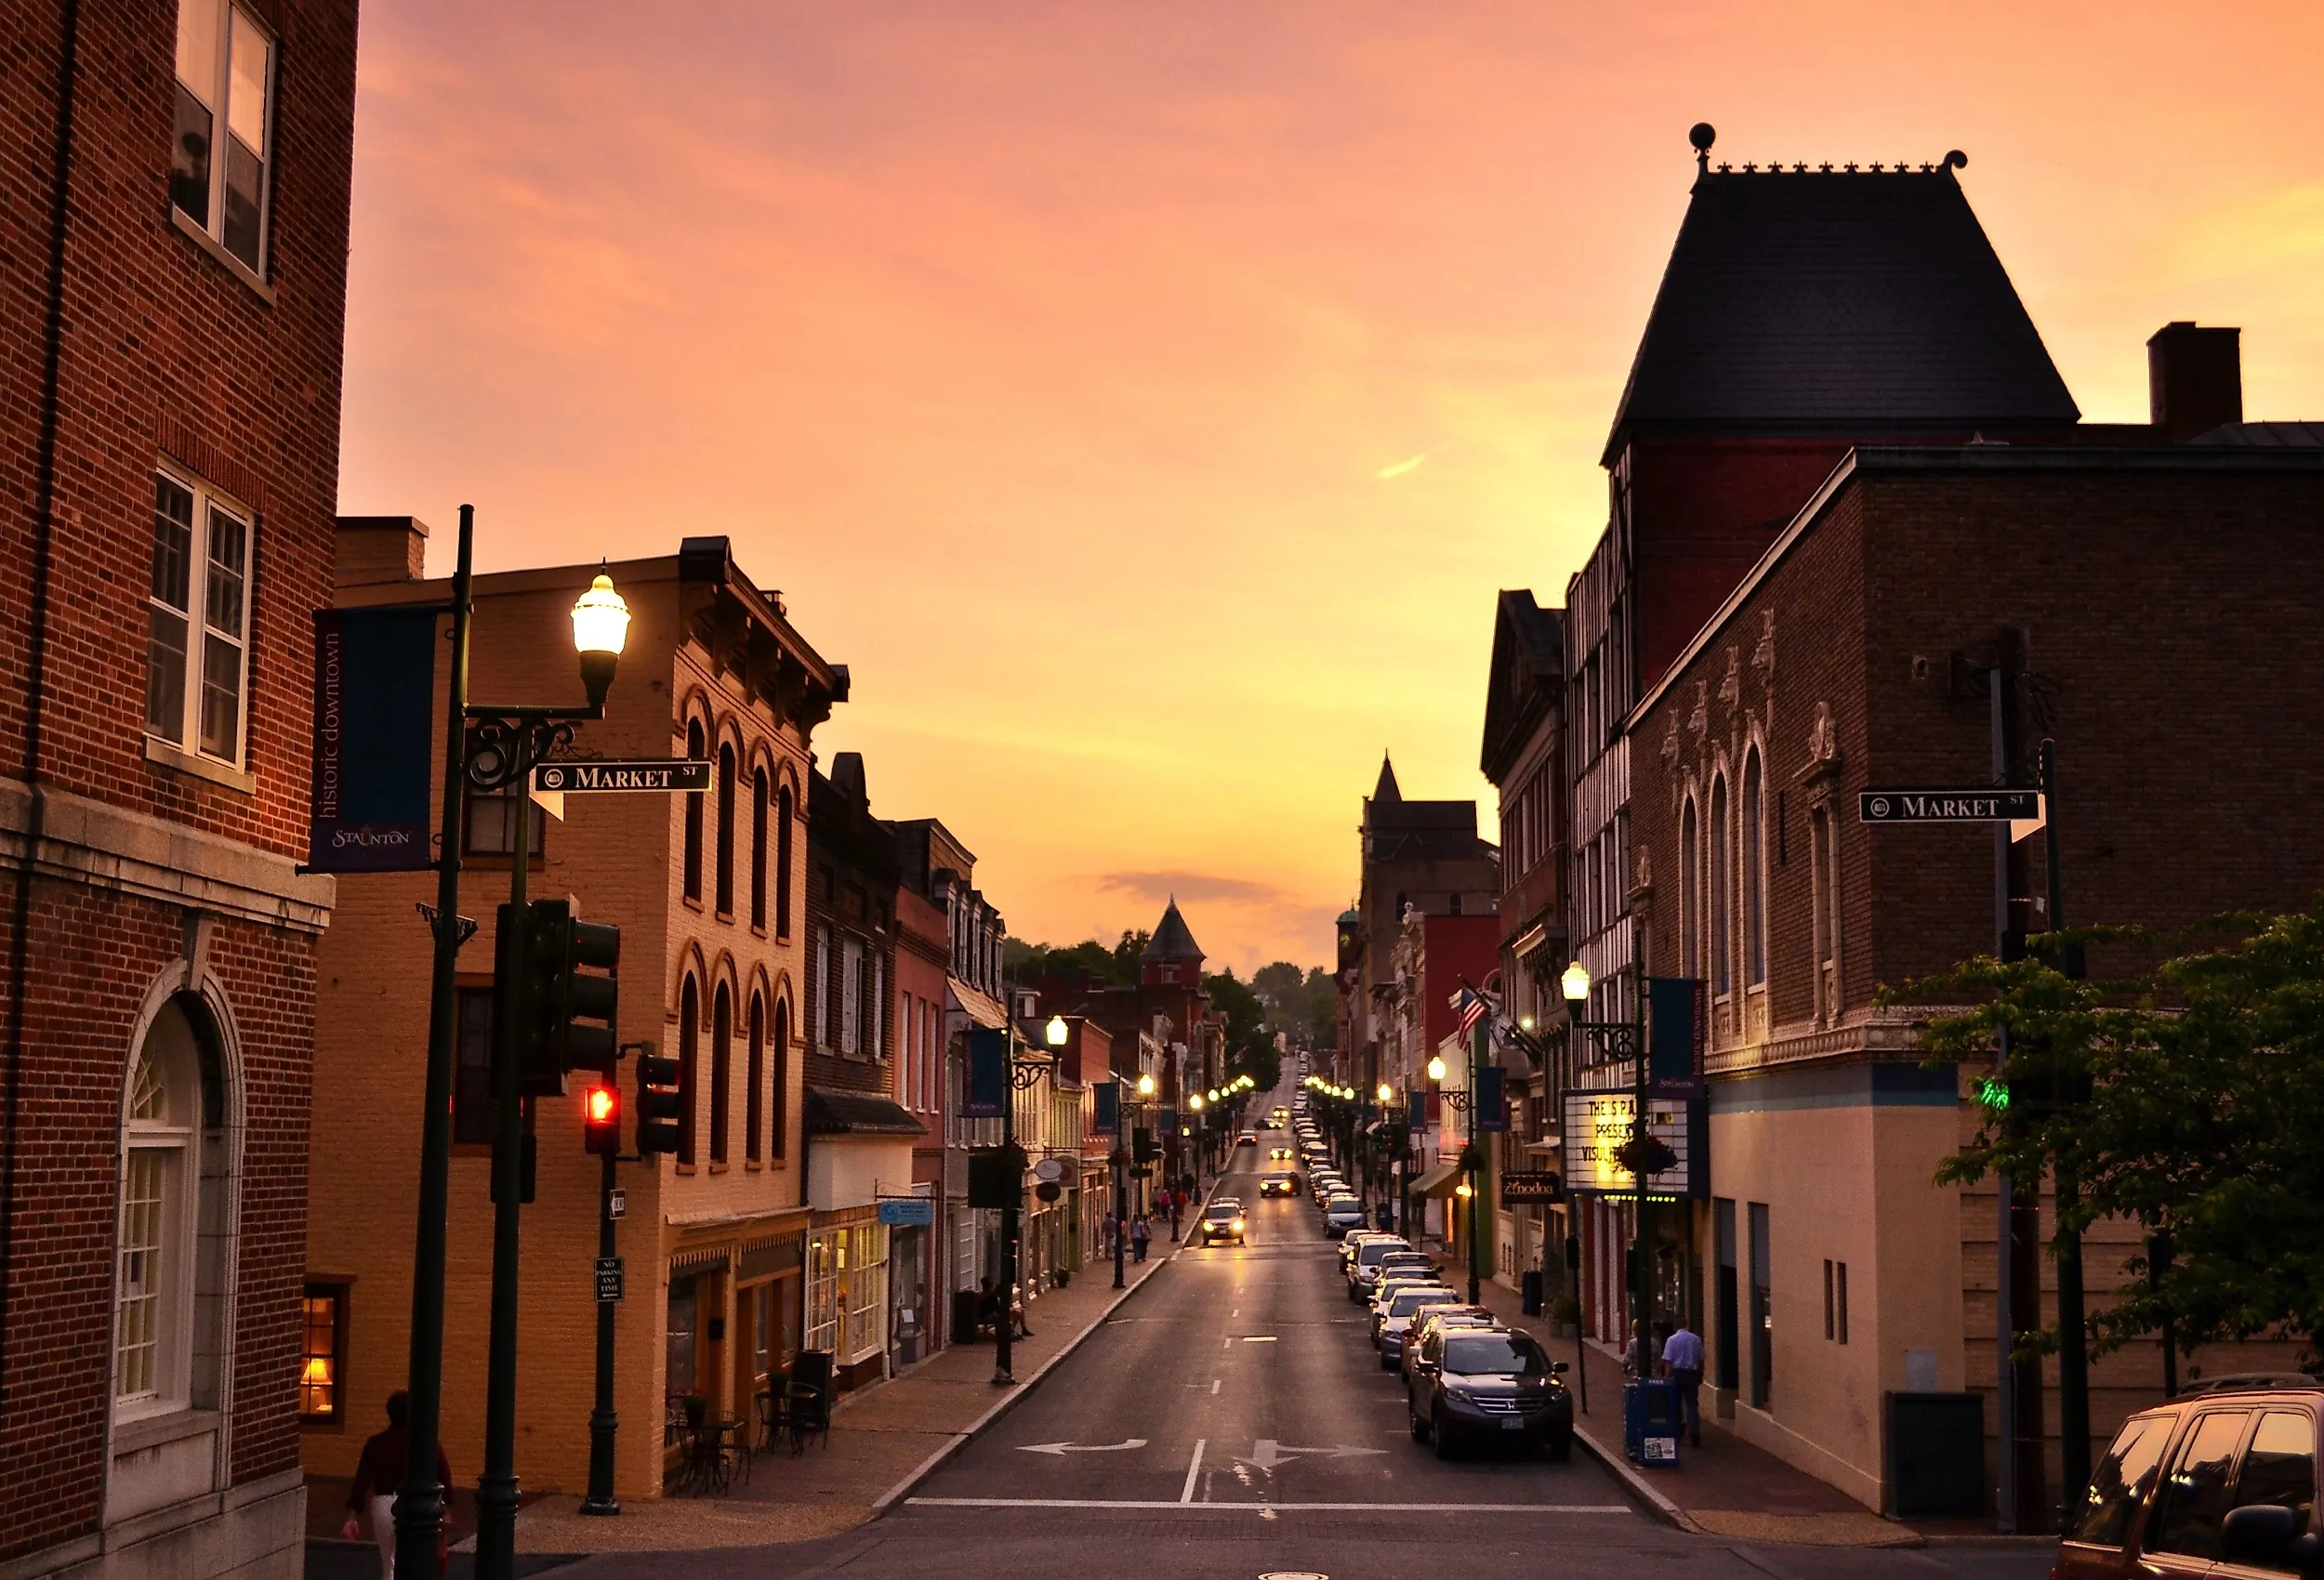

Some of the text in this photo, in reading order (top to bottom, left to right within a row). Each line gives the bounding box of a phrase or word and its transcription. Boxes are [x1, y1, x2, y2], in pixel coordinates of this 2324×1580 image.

[319, 632, 339, 819] historic downtown
[575, 766, 698, 788] MARKET ST
[1902, 795, 2025, 818] MARKET ST
[1588, 1100, 1606, 1116] THE
